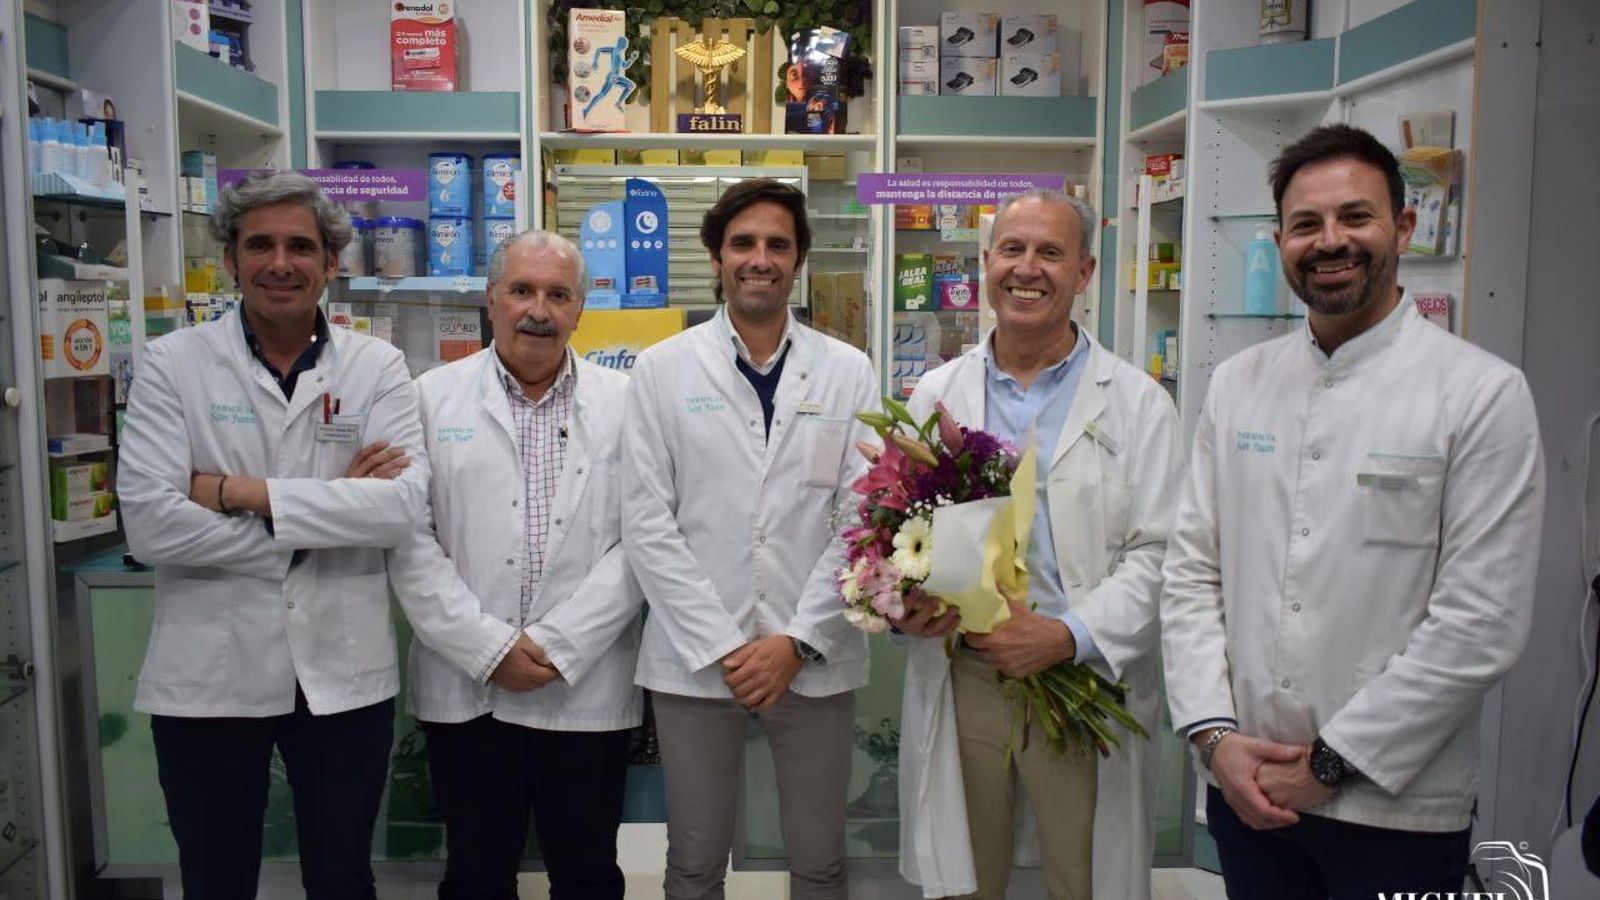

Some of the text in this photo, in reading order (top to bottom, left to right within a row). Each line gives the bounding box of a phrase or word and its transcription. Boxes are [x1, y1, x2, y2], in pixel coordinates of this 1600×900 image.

[425, 28, 447, 37] más
[396, 36, 447, 46] completo
[899, 179, 921, 187] salud
[933, 179, 997, 188] responsabilidad
[998, 180, 1008, 188] de
[346, 185, 358, 194] de
[360, 185, 409, 197] seguridad
[876, 191, 926, 200] mantenga
[927, 190, 936, 199] la
[937, 190, 982, 199] distancia
[984, 190, 996, 199] de
[57, 290, 105, 305] angileptol
[440, 323, 477, 333] GUARD
